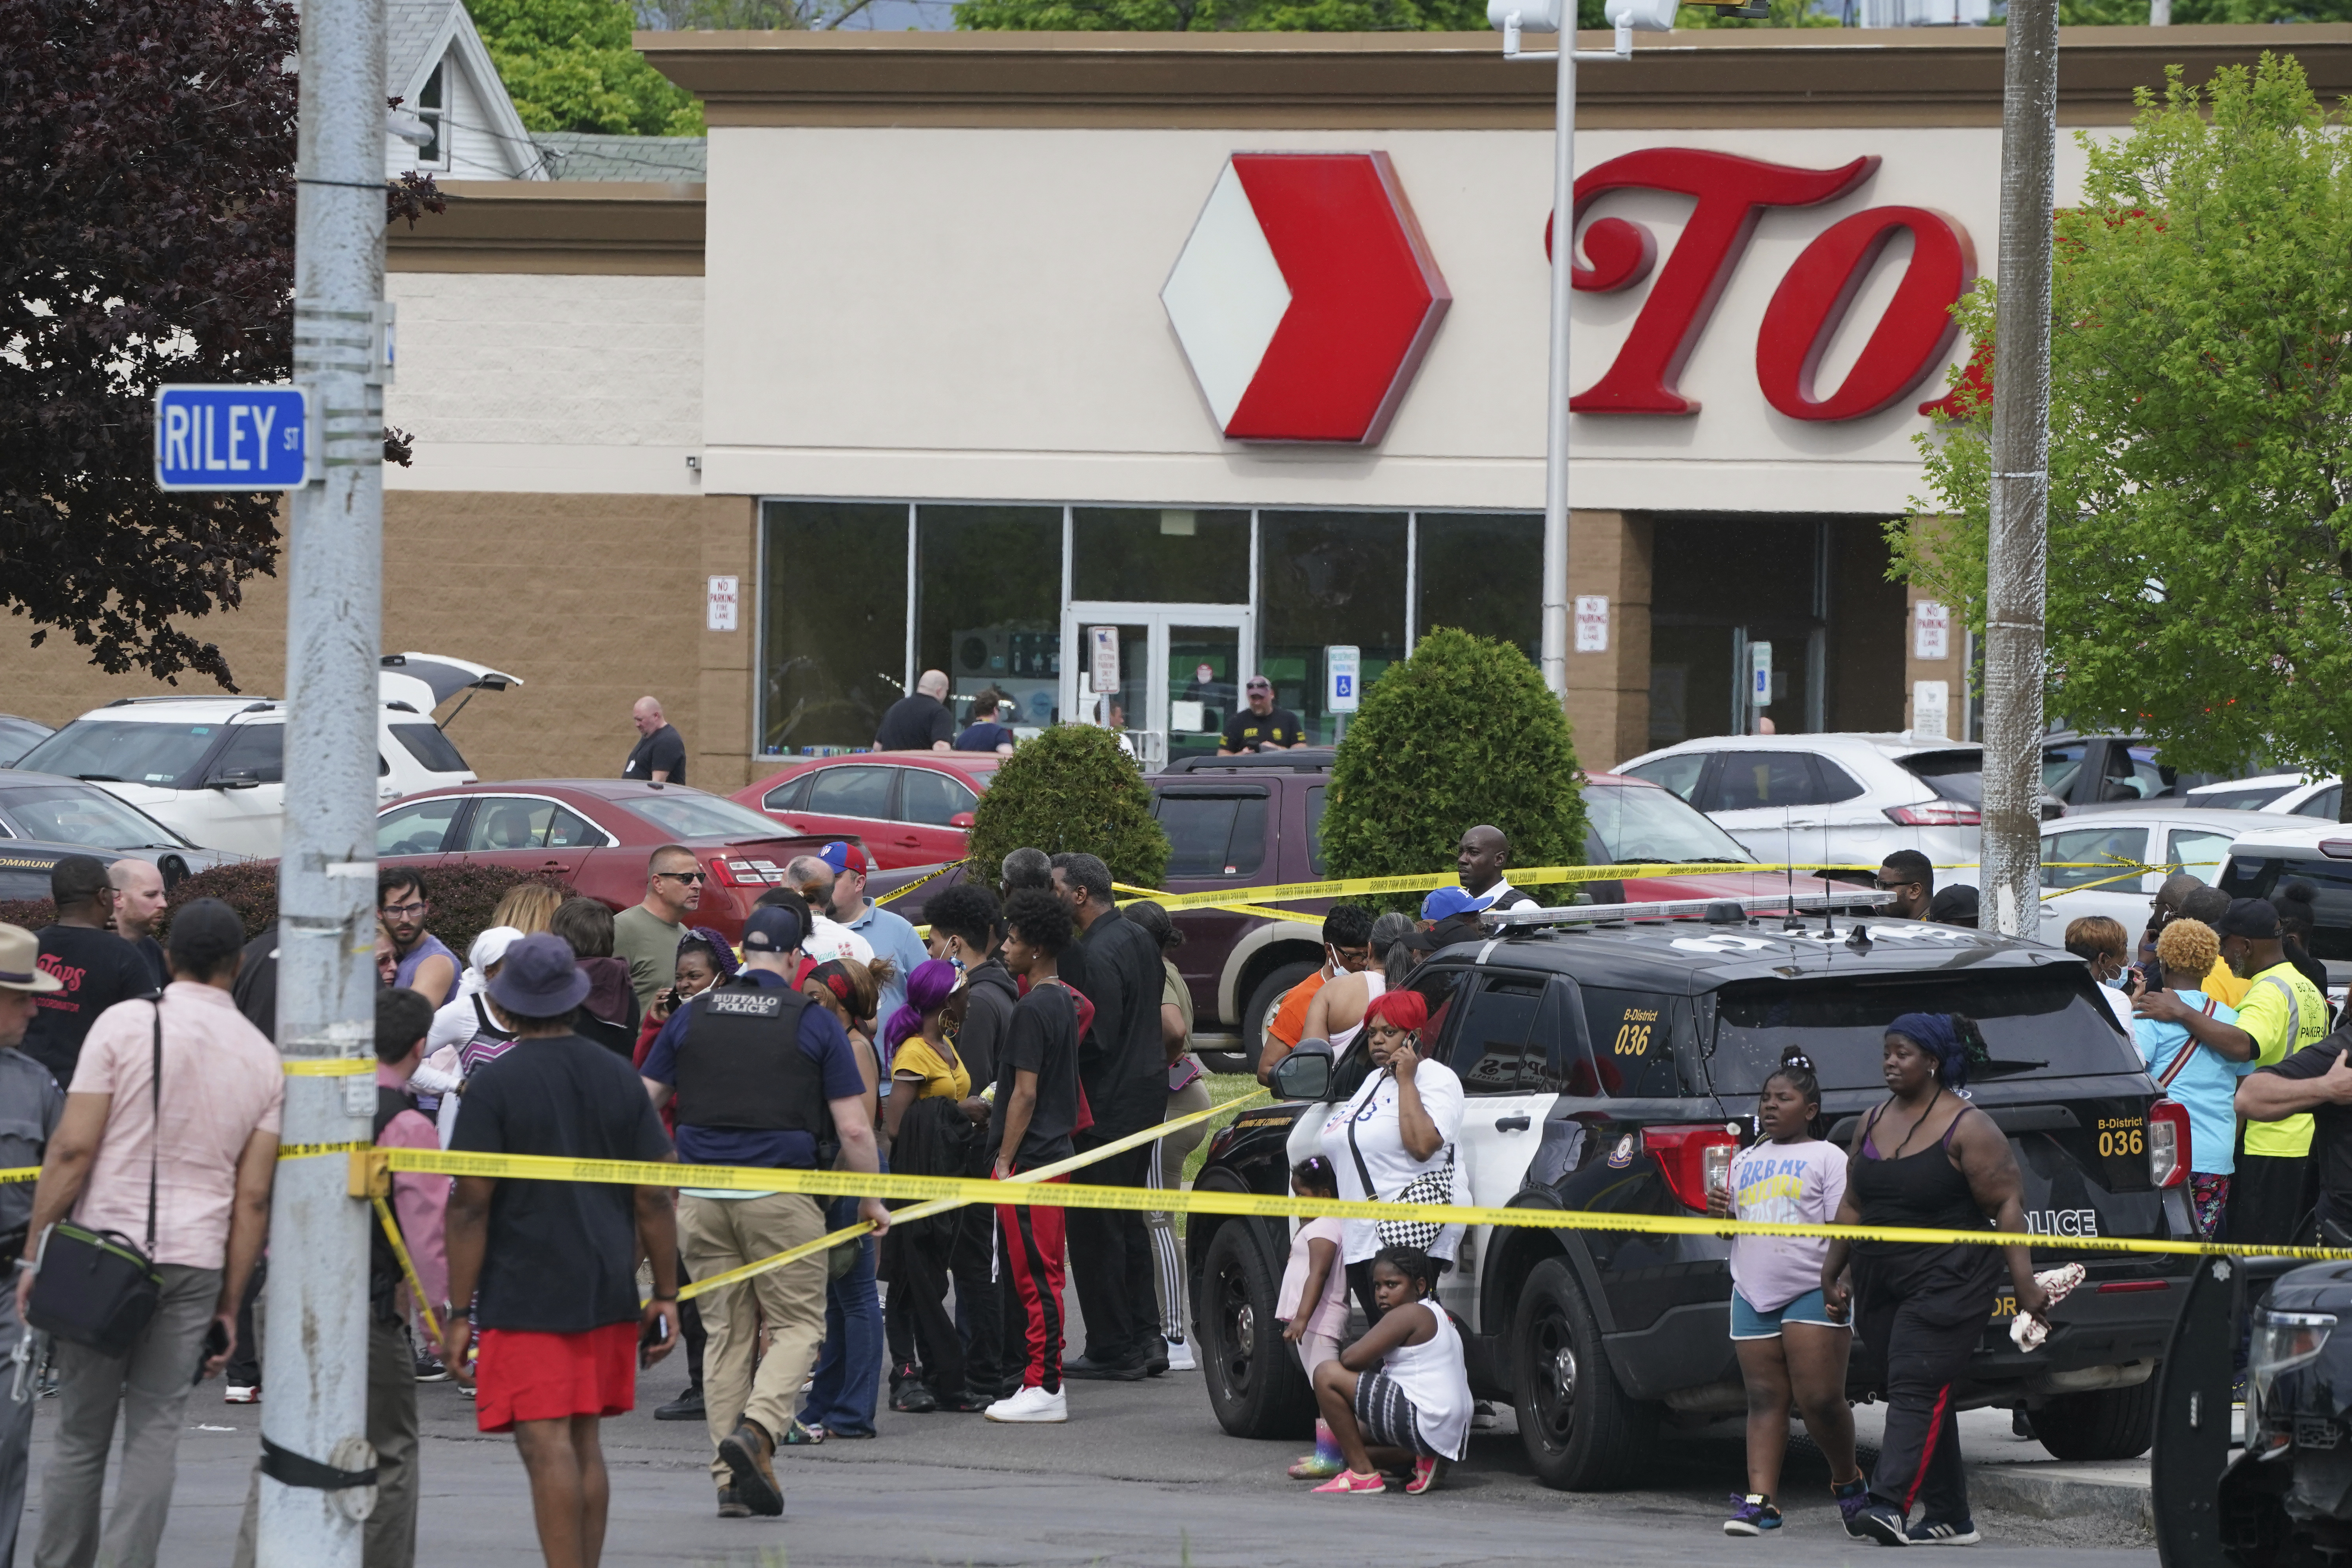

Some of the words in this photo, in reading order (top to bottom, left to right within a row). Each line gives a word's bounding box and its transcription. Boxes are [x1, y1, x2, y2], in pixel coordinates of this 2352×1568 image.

[165, 405, 277, 470] RILEY
[283, 427, 299, 451] ST
[718, 582, 728, 591] NO
[710, 593, 735, 603] PARKING
[1926, 607, 1938, 617] NO
[1918, 619, 1946, 629] PARKING
[712, 994, 778, 1006] BUFFALO
[716, 1002, 769, 1014] POLICE
[1623, 1009, 1658, 1022] B-District
[1615, 1024, 1651, 1056] 036
[2098, 1116, 2143, 1129] B-District
[2099, 1129, 2143, 1157] 036
[1739, 1160, 1776, 1191] BRB
[1778, 1160, 1808, 1179] MY
[1738, 1175, 1804, 1207] UNICORN
